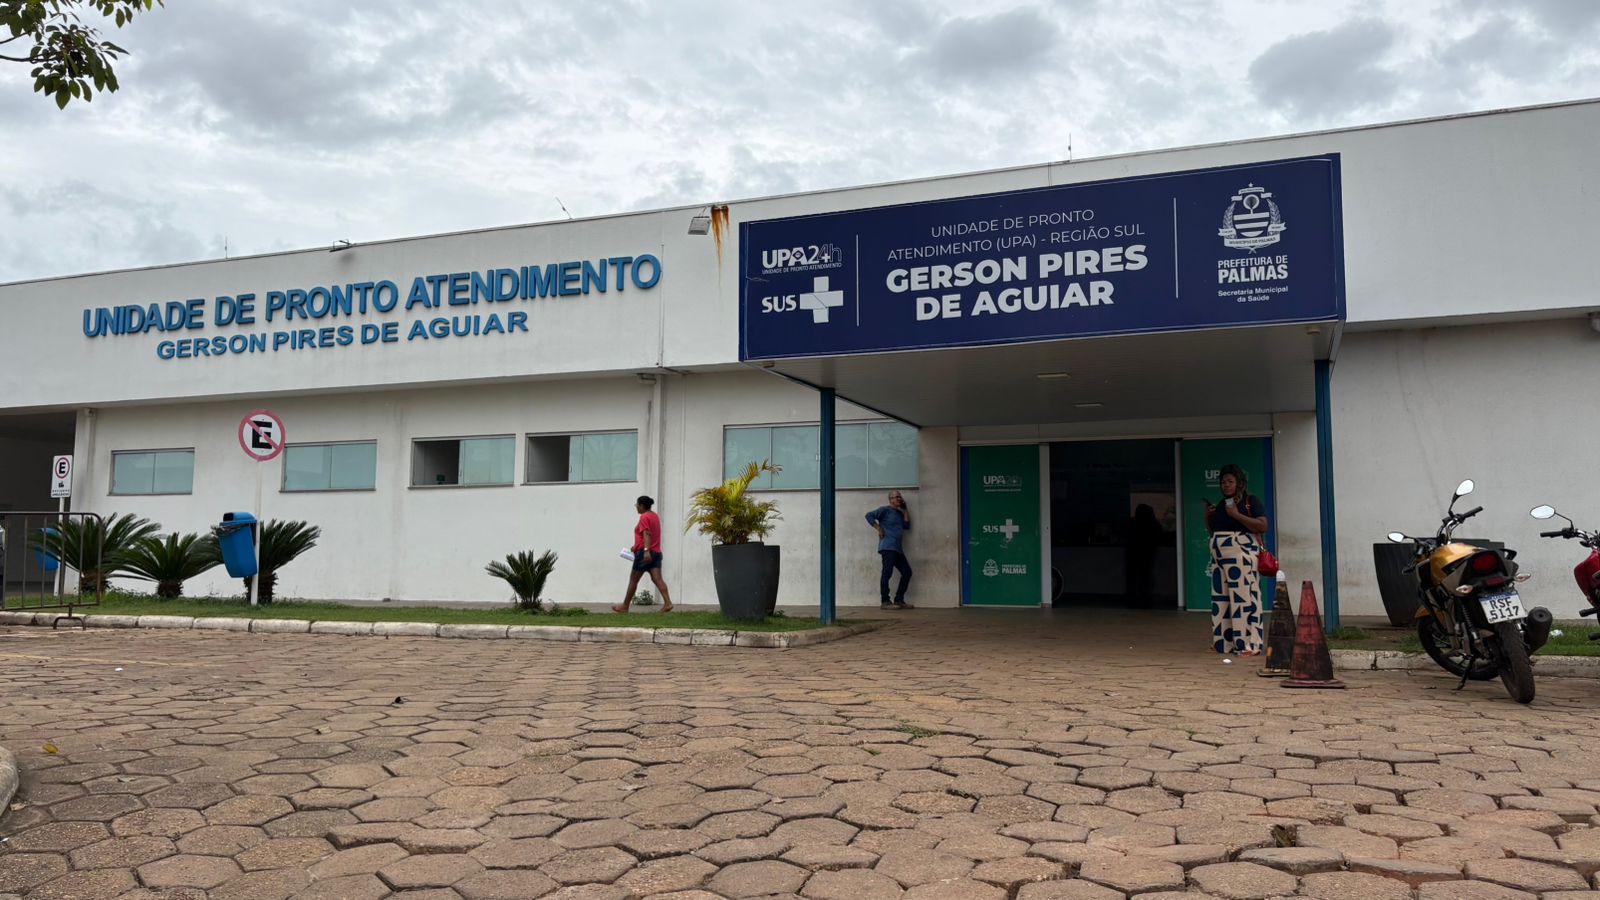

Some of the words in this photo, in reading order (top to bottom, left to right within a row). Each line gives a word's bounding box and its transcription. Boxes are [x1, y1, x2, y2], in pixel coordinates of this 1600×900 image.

[931, 219, 1000, 238] UNIDADE
[1003, 217, 1024, 230] DE
[1028, 209, 1095, 227] PRONTO
[887, 239, 992, 261] ATENDIMENTO
[996, 234, 1037, 252] (UPA)
[1050, 225, 1110, 244] REGIÃO
[1114, 223, 1145, 238] SUL
[886, 256, 1027, 293] GERSON
[1039, 244, 1148, 279] PIRES
[1218, 256, 1273, 269] PREFEITURA
[1275, 255, 1288, 264] DE
[1218, 264, 1288, 284] PALMAS
[83, 298, 205, 338] UNIDADE
[214, 293, 256, 327] DE
[265, 279, 399, 322] PRONTO
[405, 254, 662, 310] ATENDIMENTO
[916, 294, 962, 321] DE
[970, 280, 1115, 317] AGUIAR
[1218, 288, 1253, 297] Secretaria
[1255, 285, 1288, 296] Municipal
[1247, 294, 1270, 302] Saúde
[762, 294, 797, 313] SUS
[157, 333, 267, 360] GERSON
[272, 325, 354, 351] PIRES
[360, 321, 399, 345] DE
[407, 311, 529, 340] AGUIAR
[251, 420, 272, 449] E
[58, 461, 66, 474] E
[982, 525, 999, 533] SUS
[1001, 567, 1027, 575] PALMAS
[1489, 597, 1512, 609] RSF
[1490, 605, 1519, 620] 5117
